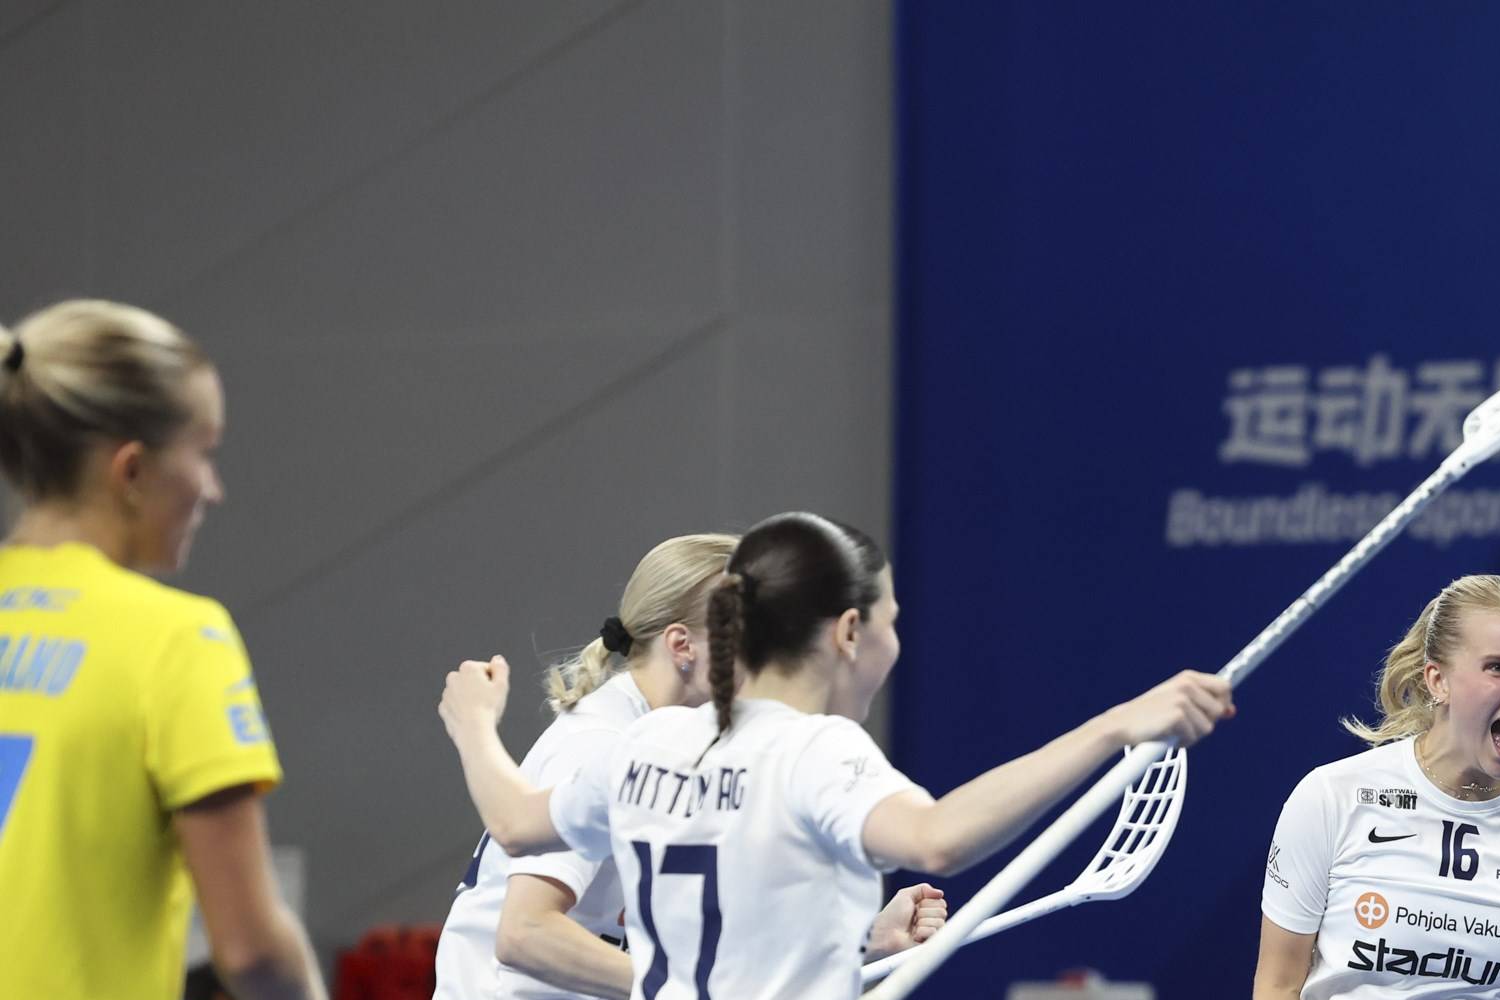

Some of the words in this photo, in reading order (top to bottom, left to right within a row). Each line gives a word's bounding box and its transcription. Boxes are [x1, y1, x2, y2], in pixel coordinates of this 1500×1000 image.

[1379, 794, 1418, 810] SPORT
[1439, 820, 1480, 881] 16
[1395, 906, 1457, 932] Pohjola
